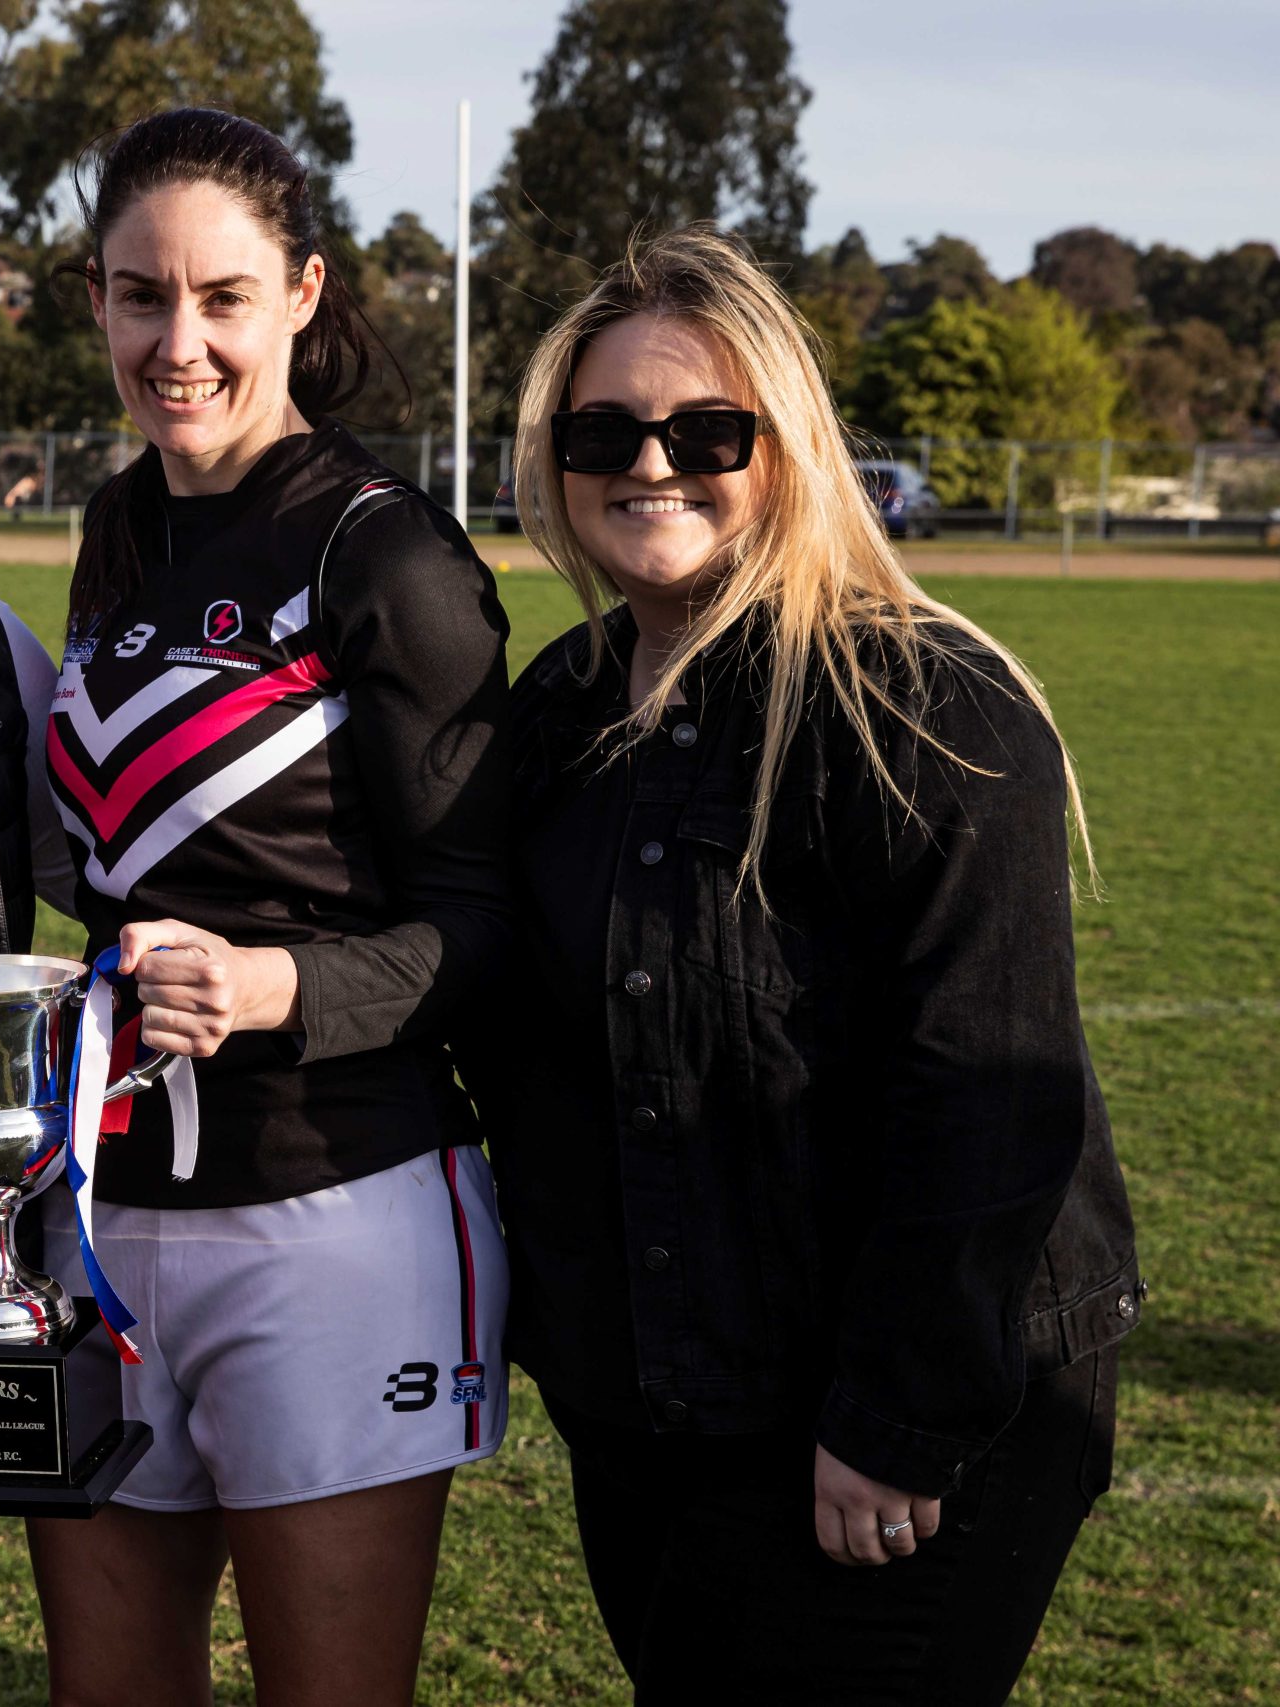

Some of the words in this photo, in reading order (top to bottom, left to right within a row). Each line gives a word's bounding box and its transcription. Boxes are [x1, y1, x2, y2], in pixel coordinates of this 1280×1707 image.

[167, 647, 201, 656] CASEY
[201, 648, 260, 663] THUNDER
[450, 1384, 487, 1405] SFNL
[12, 1422, 45, 1430] LEAGUE
[3, 1451, 22, 1461] F.C.
